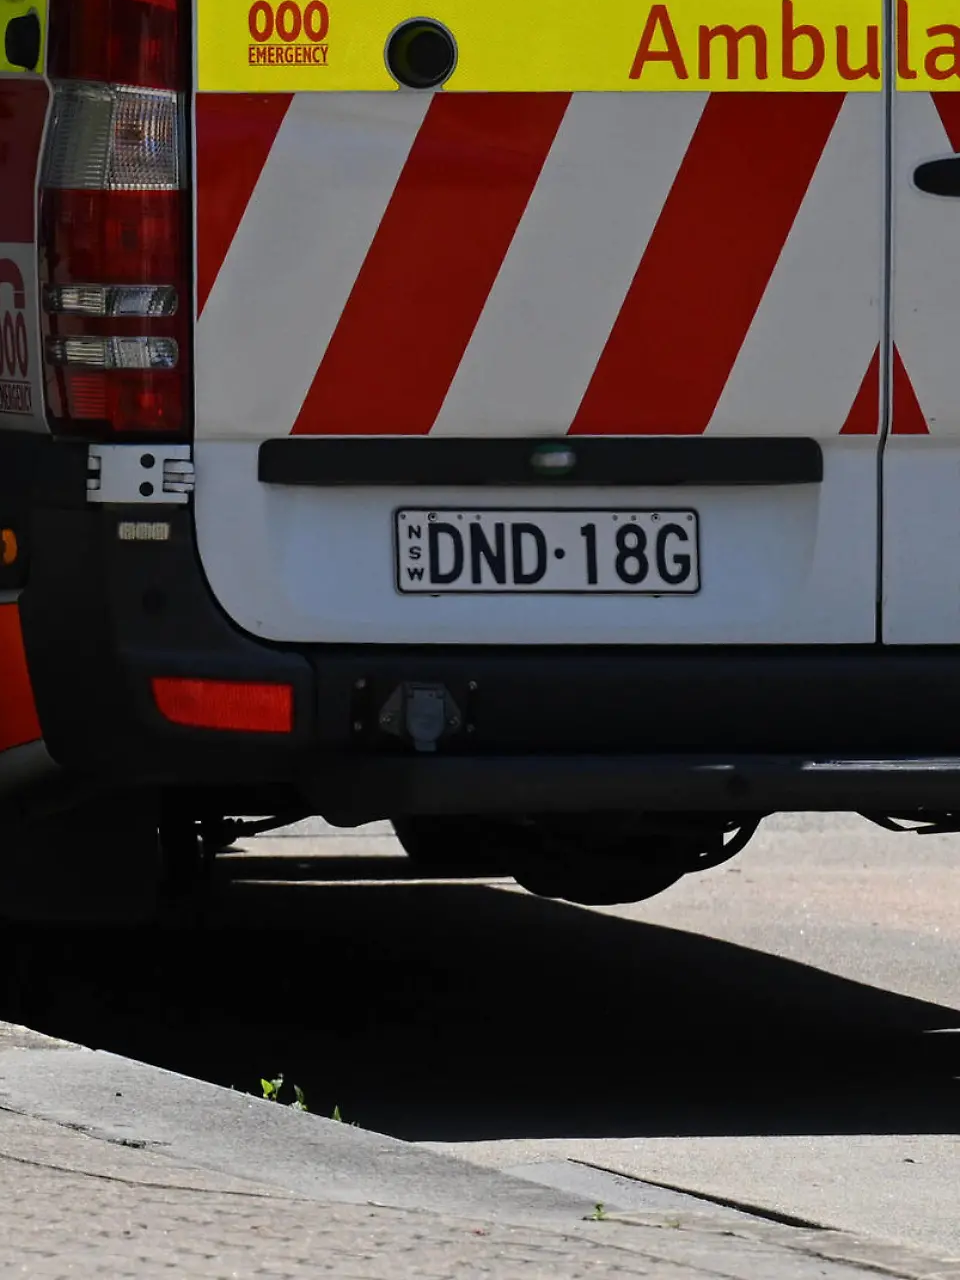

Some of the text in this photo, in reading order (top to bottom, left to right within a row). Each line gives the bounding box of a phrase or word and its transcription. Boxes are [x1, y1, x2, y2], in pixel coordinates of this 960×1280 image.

[248, 0, 329, 42] 000
[248, 46, 329, 63] EMERGENCY
[407, 525, 424, 581] NSW
